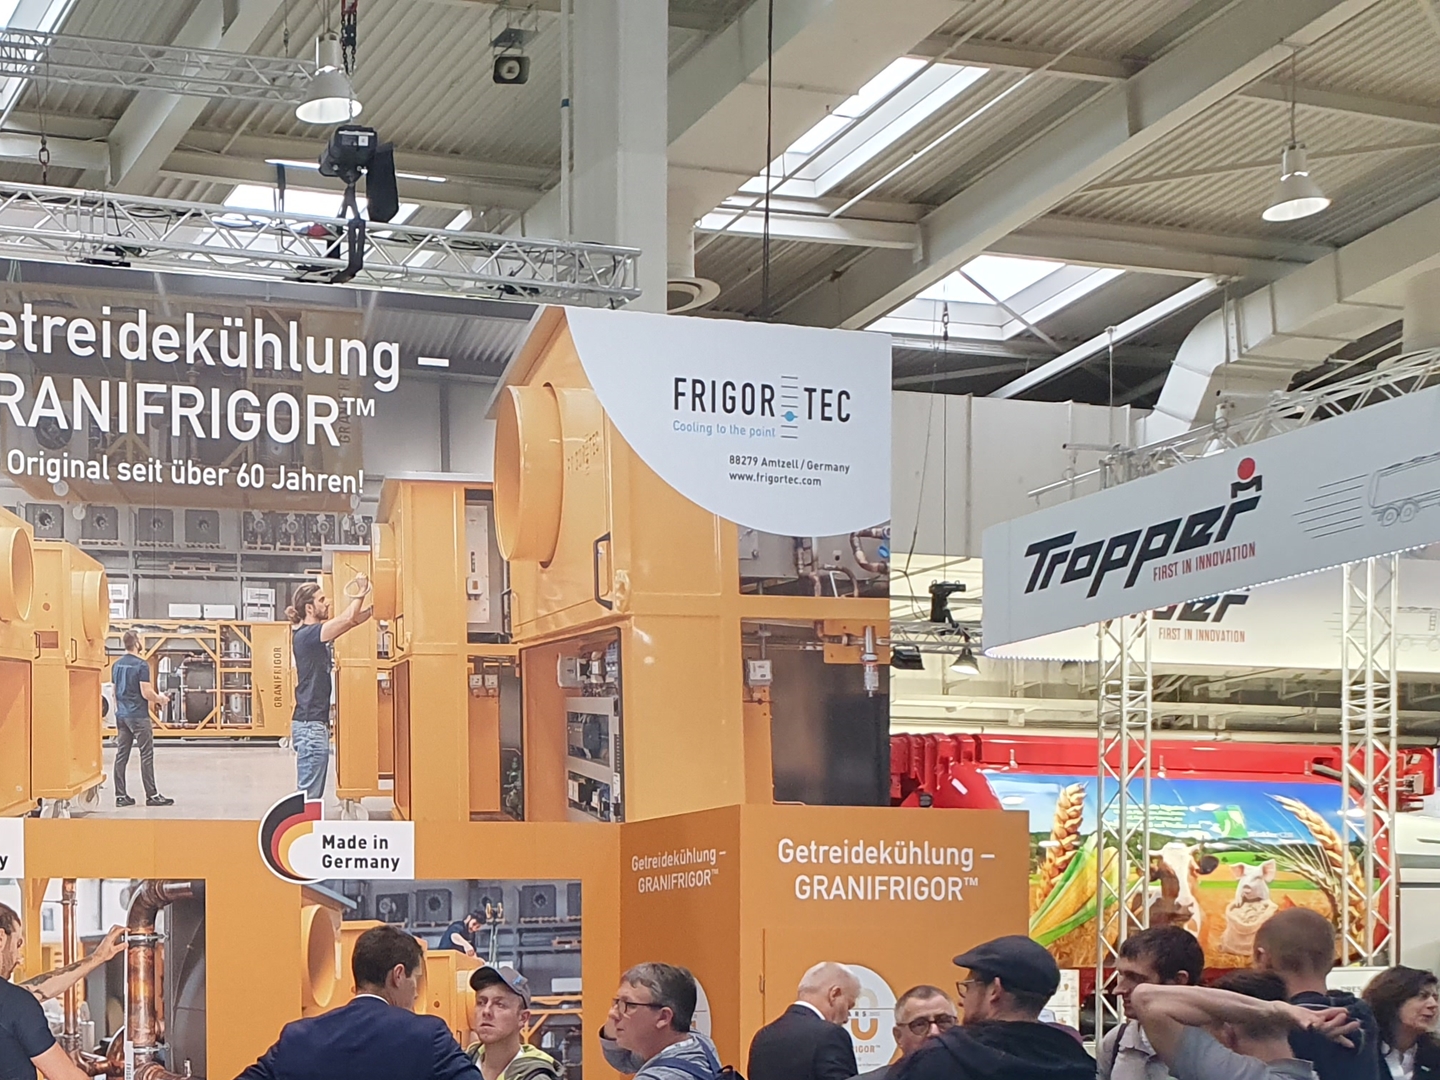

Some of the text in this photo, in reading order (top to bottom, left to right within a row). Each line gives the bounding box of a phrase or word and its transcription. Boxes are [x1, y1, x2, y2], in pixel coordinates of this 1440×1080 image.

[673, 420, 776, 438] Cooling to the point
[6, 449, 109, 484] Original
[117, 457, 162, 484] seit
[171, 460, 228, 487] über
[236, 465, 265, 489] 60
[272, 467, 364, 494] Jahren!
[729, 455, 758, 467] 88279
[761, 457, 799, 469] Amtzell
[806, 460, 850, 474] Germany
[729, 471, 822, 486] www.frigortec.com
[1153, 541, 1256, 582] FIRST IN INNOVATION
[1159, 627, 1245, 643] FIRST IN INNOVATION
[322, 834, 389, 850] Made in
[322, 854, 400, 873] Germany
[631, 847, 716, 871] Getreidekühlung
[777, 837, 974, 872] Getreidekühlung
